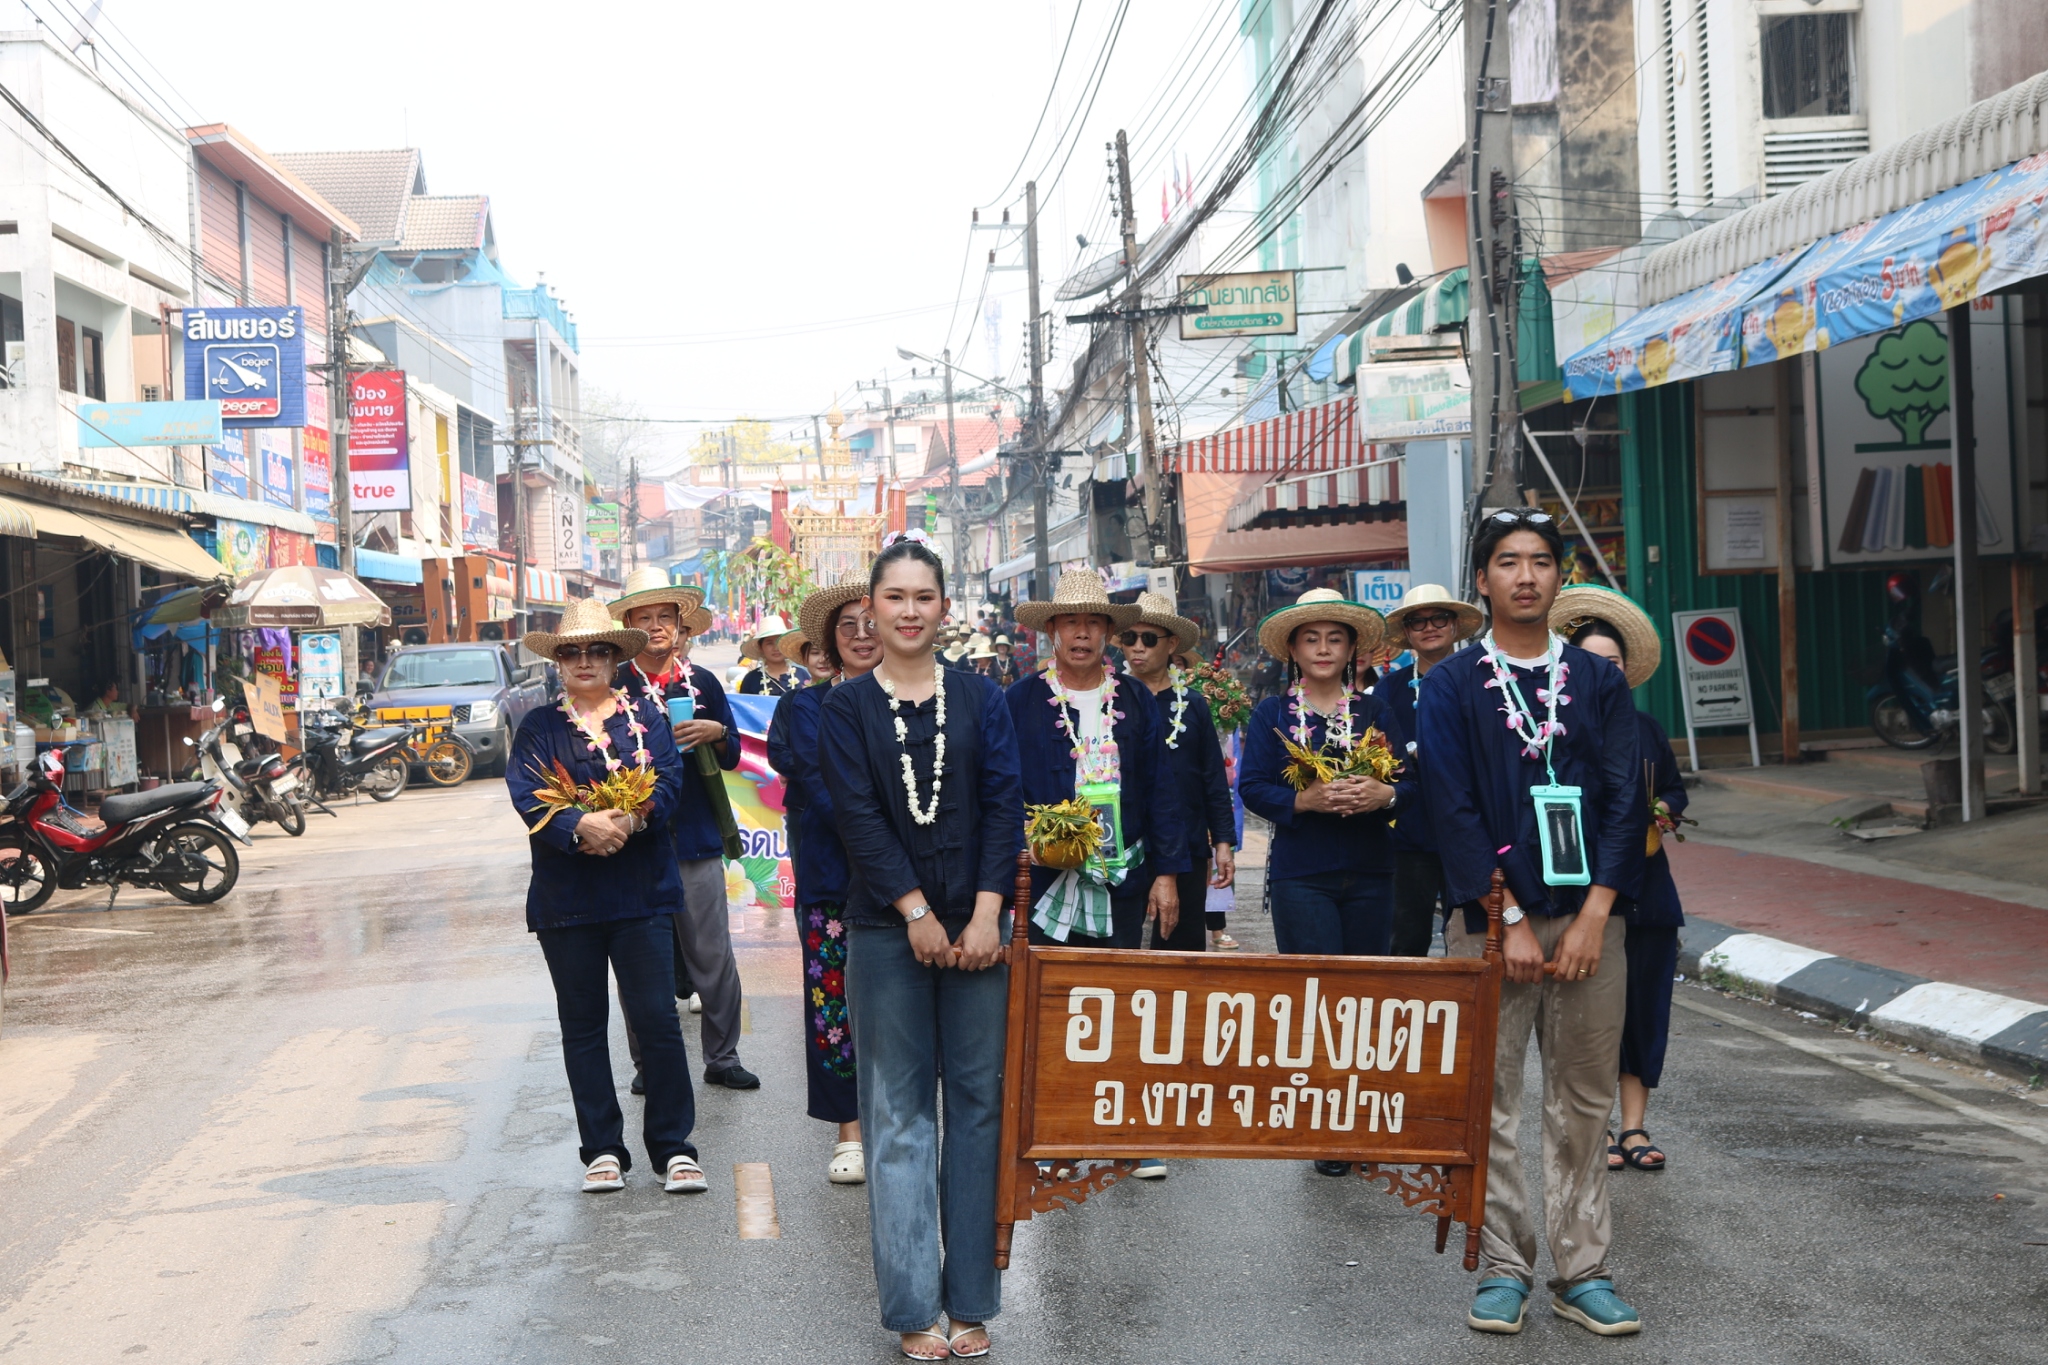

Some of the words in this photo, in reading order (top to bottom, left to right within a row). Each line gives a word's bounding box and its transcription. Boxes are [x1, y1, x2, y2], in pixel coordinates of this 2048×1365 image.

[1880, 257, 1895, 301] 5
[1895, 262, 1920, 289] บาท
[187, 310, 297, 340] สีเบเยอร์
[241, 358, 273, 367] beger
[221, 400, 268, 414] beger
[162, 421, 199, 434] ATM
[353, 483, 395, 498] true
[1364, 576, 1403, 600] เต็ง
[1698, 685, 1707, 693] NO
[1709, 683, 1739, 693] PARKING
[263, 700, 281, 718] AUX
[1093, 1080, 1214, 1127] อ.งาว
[1228, 1073, 1405, 1133] จ.ลำปาง
